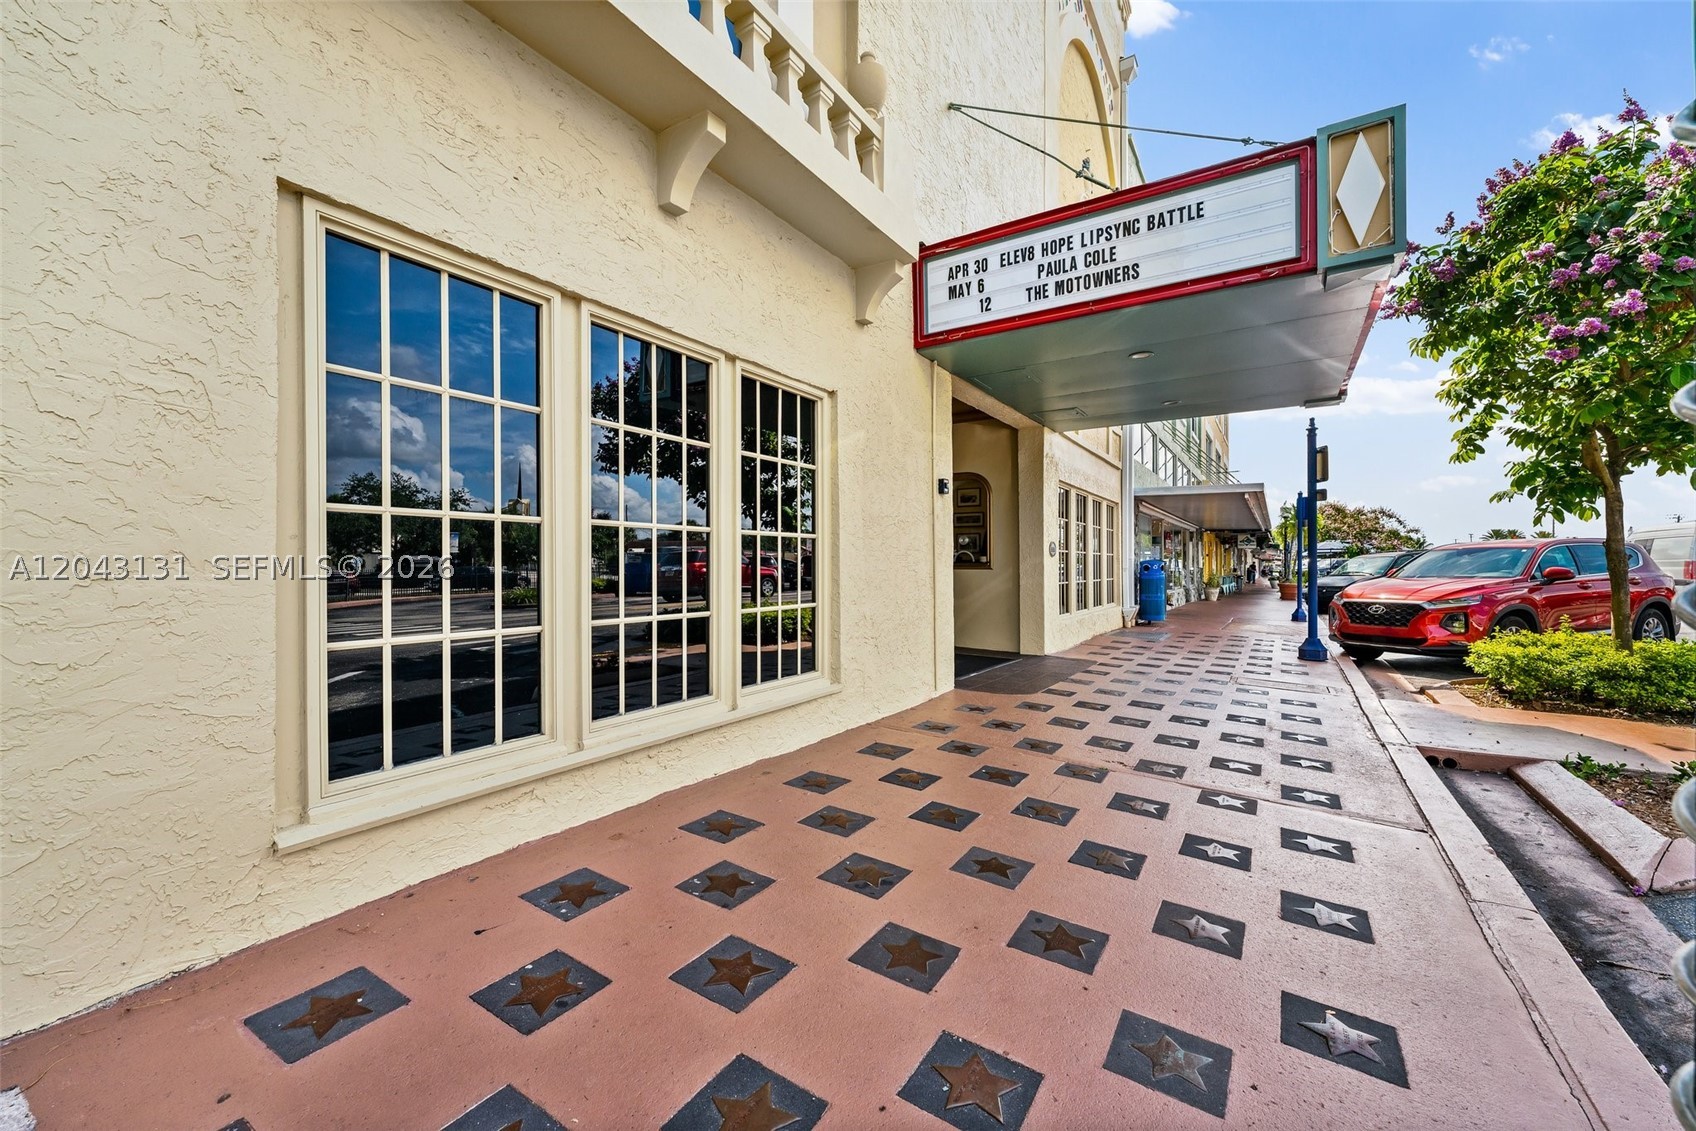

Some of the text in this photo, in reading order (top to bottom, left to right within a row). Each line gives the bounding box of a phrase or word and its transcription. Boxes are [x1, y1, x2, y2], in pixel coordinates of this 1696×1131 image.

[948, 201, 1205, 281] APR 30 ELEV8 HOPE LIPSYNC BATTLE
[948, 246, 1117, 300] MAY 6 PAULA COLE
[979, 262, 1140, 313] 12 THE MOTOWNERS
